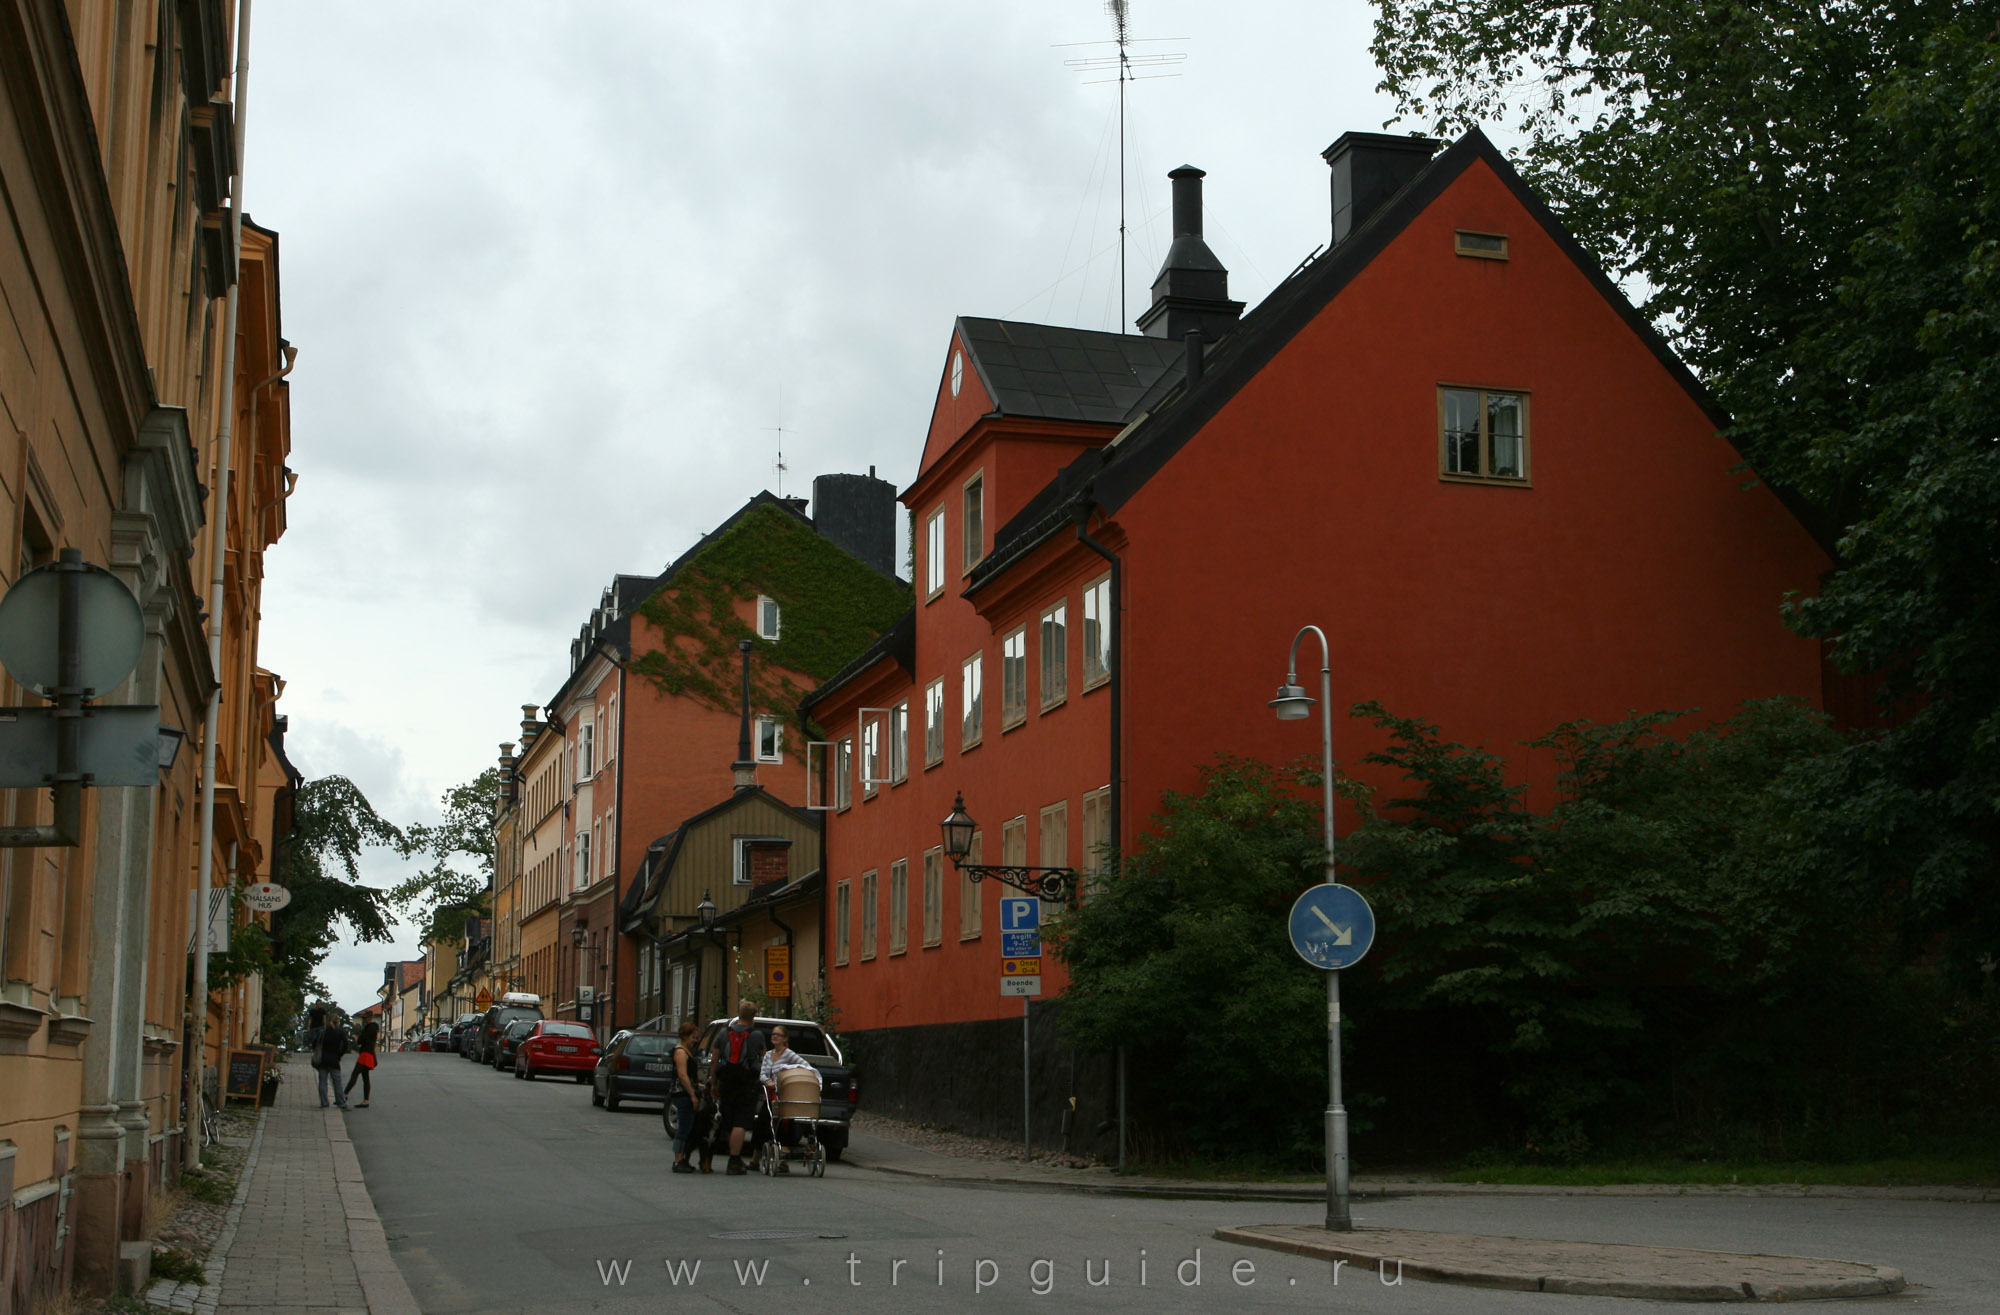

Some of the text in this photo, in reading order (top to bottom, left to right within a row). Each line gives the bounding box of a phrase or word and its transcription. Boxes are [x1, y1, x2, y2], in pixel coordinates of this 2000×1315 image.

[1012, 901, 1031, 928] P
[1011, 933, 1032, 941] Avgift
[582, 990, 590, 999] P
